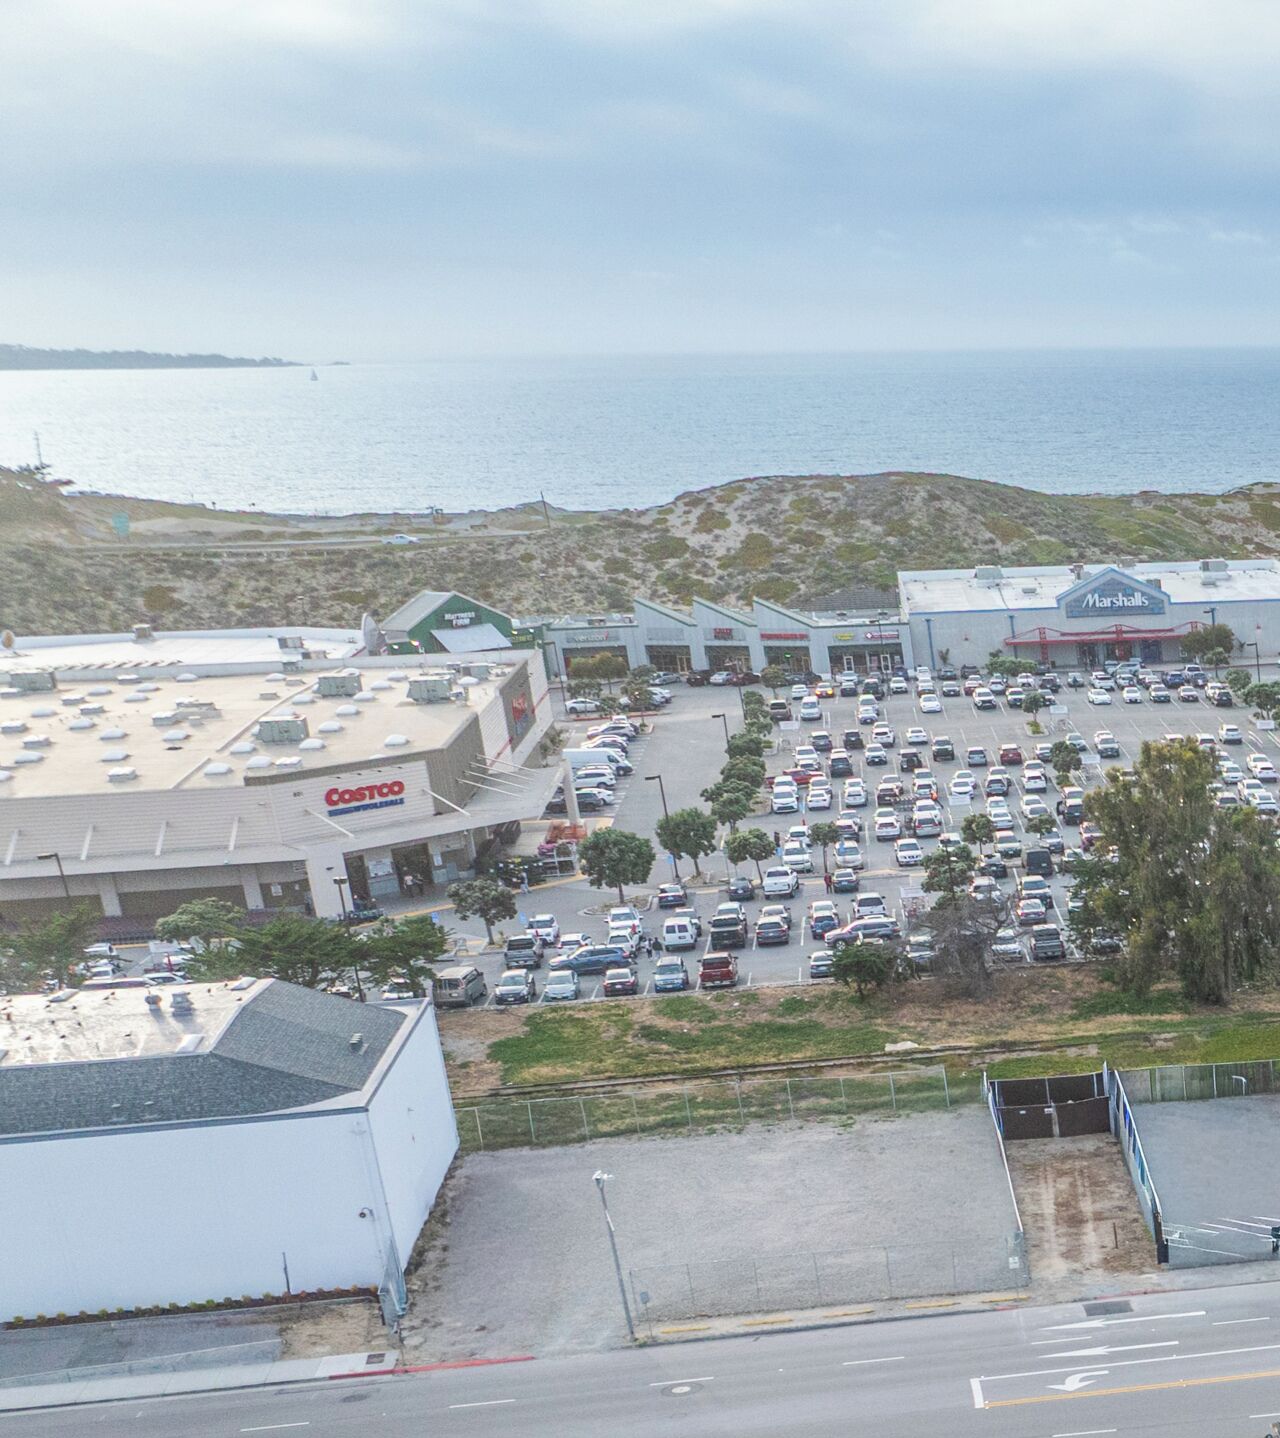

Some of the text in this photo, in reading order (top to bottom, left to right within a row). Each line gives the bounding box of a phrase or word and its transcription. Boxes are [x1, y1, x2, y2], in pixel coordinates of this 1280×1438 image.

[1081, 591, 1149, 609] Marshalls
[574, 634, 606, 643] verizon
[325, 780, 405, 806] COSTCO
